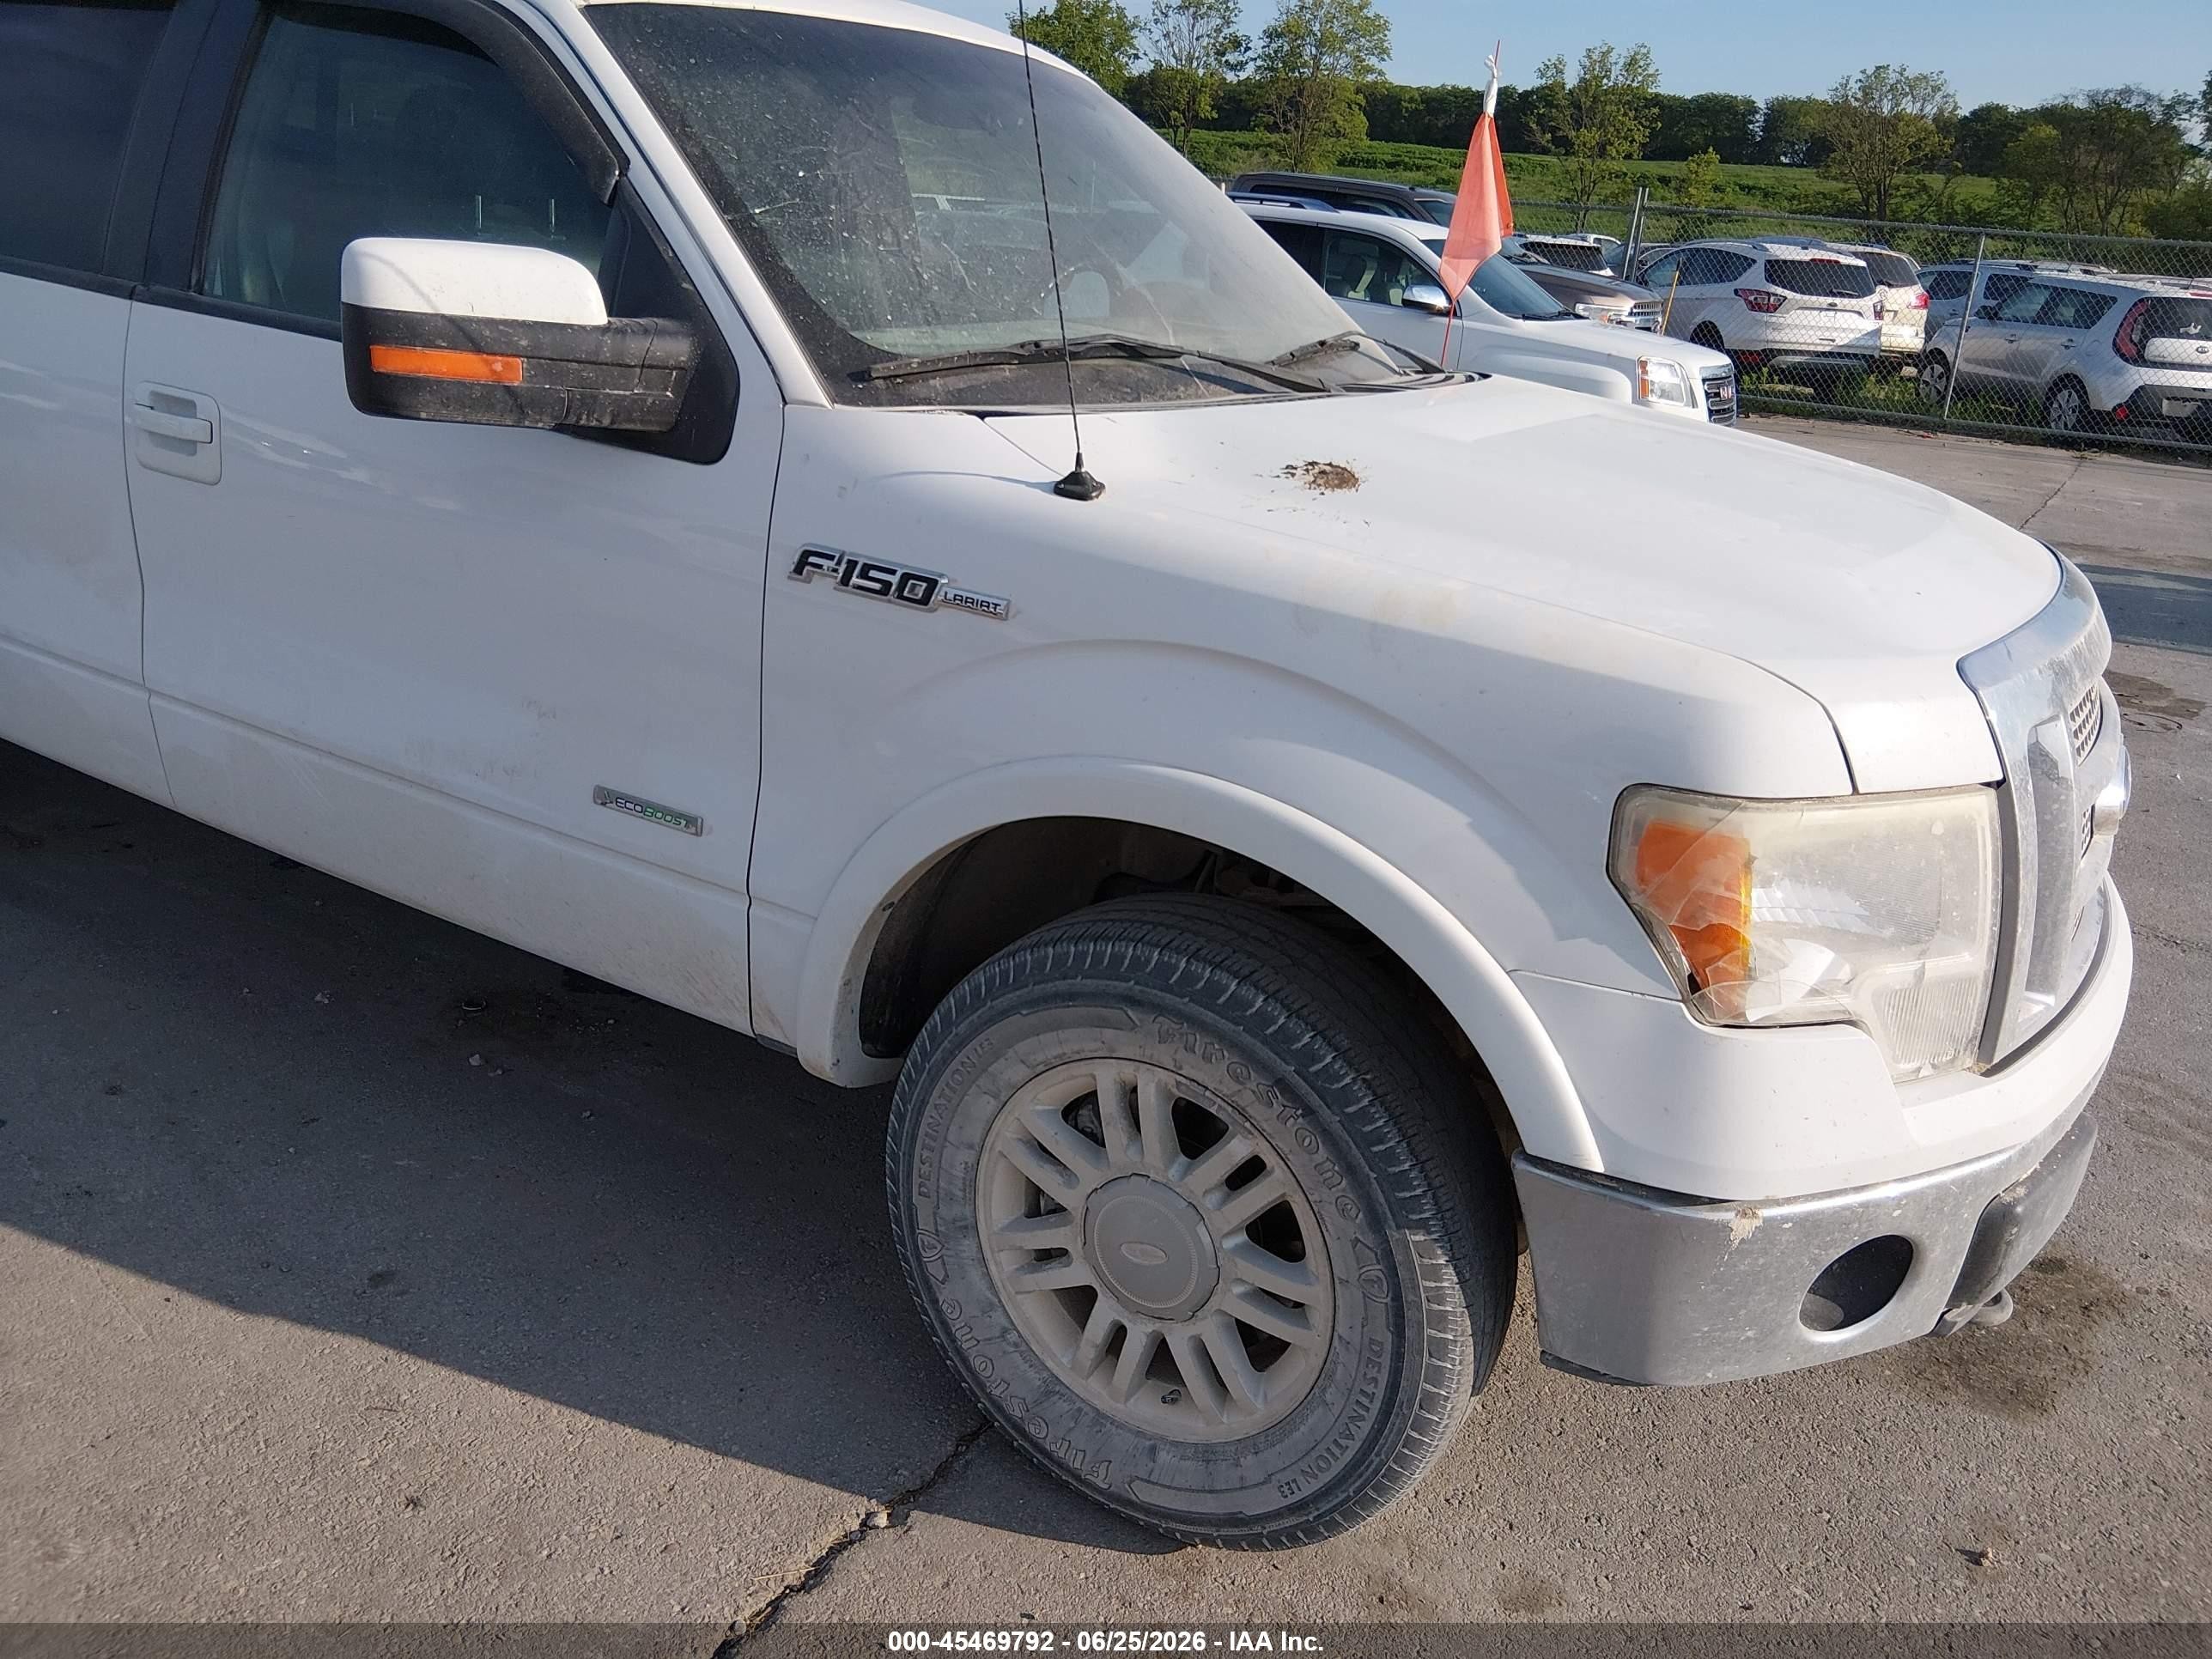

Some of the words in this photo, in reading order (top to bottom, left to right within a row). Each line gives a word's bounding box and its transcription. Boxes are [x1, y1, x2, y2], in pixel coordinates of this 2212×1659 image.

[791, 547, 942, 608] F-150
[944, 590, 1003, 616] LARIAT
[615, 796, 690, 830] ECOBOOST
[917, 1055, 977, 1200] DESTINATION
[1152, 1012, 1362, 1224] Firestone
[940, 1297, 1114, 1492] Firestone
[1299, 1336, 1385, 1486] DESTINATION
[1277, 1477, 1303, 1499] LE3
